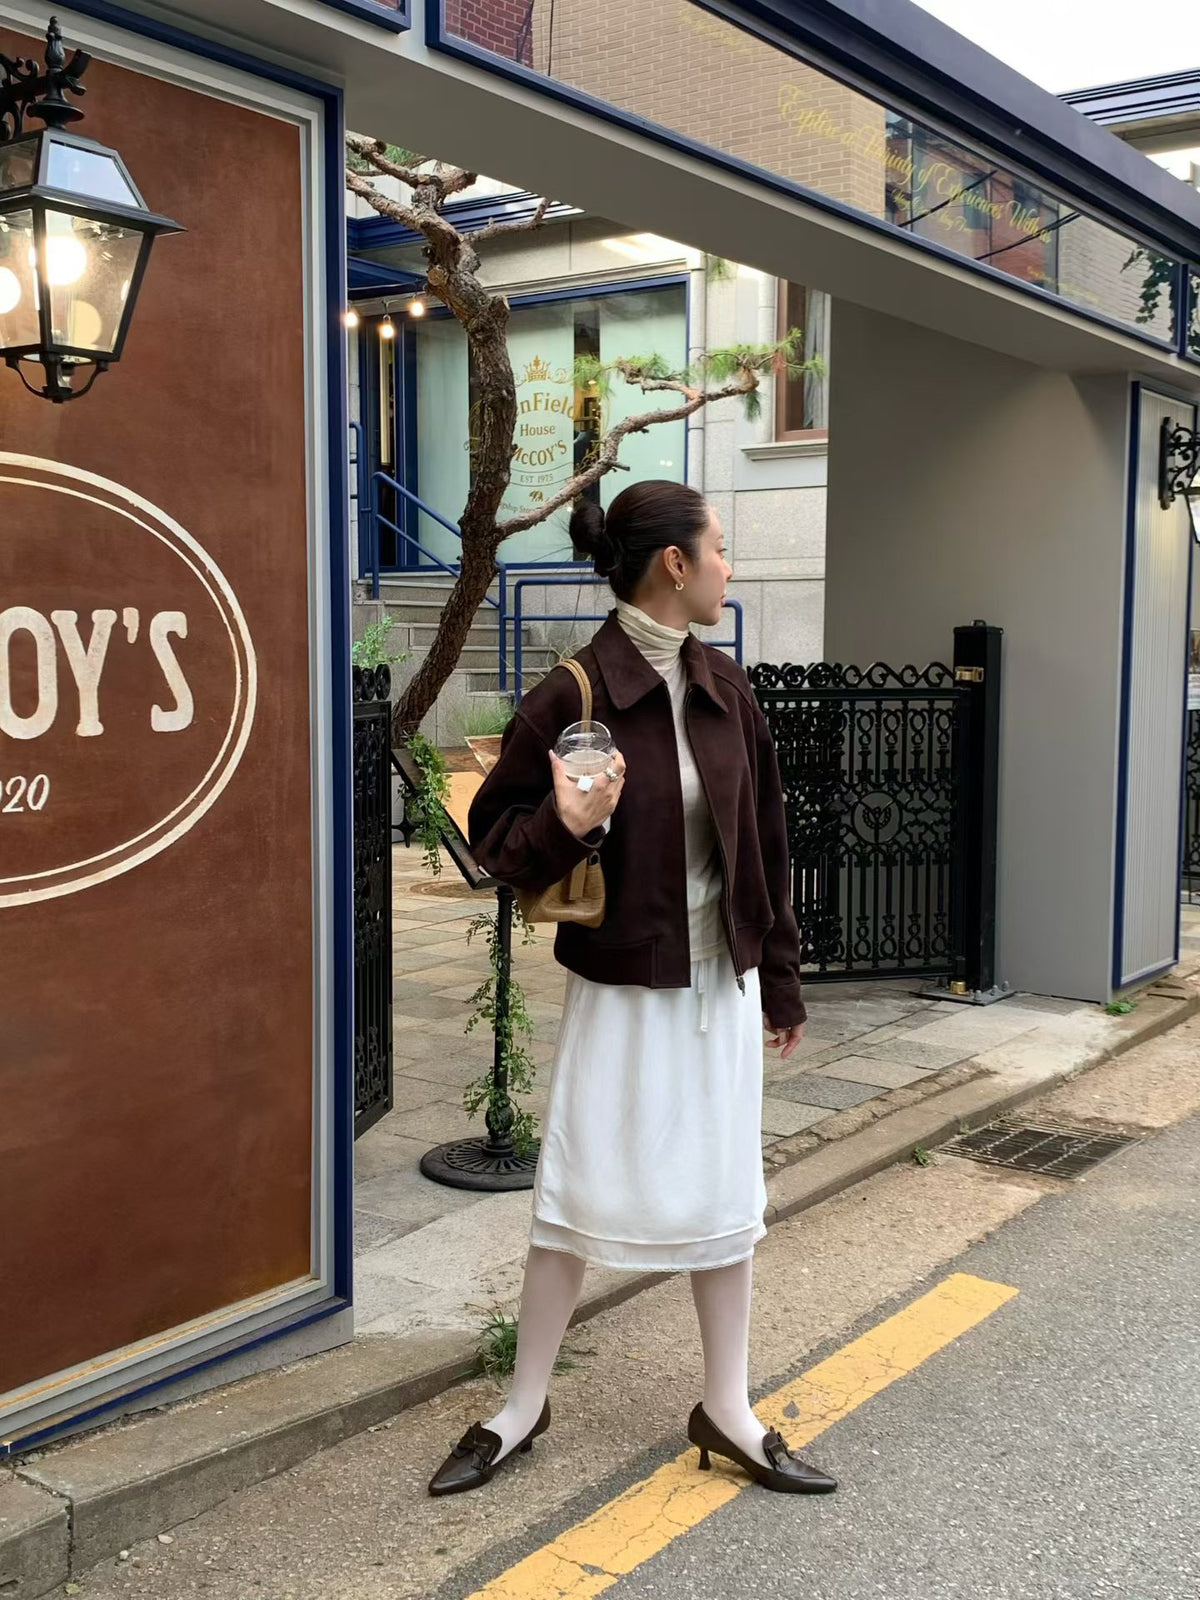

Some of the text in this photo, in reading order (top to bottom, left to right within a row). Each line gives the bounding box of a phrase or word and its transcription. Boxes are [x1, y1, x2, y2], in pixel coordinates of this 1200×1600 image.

[520, 424, 556, 437] House
[520, 475, 534, 484] EST
[0, 773, 50, 813] 20
